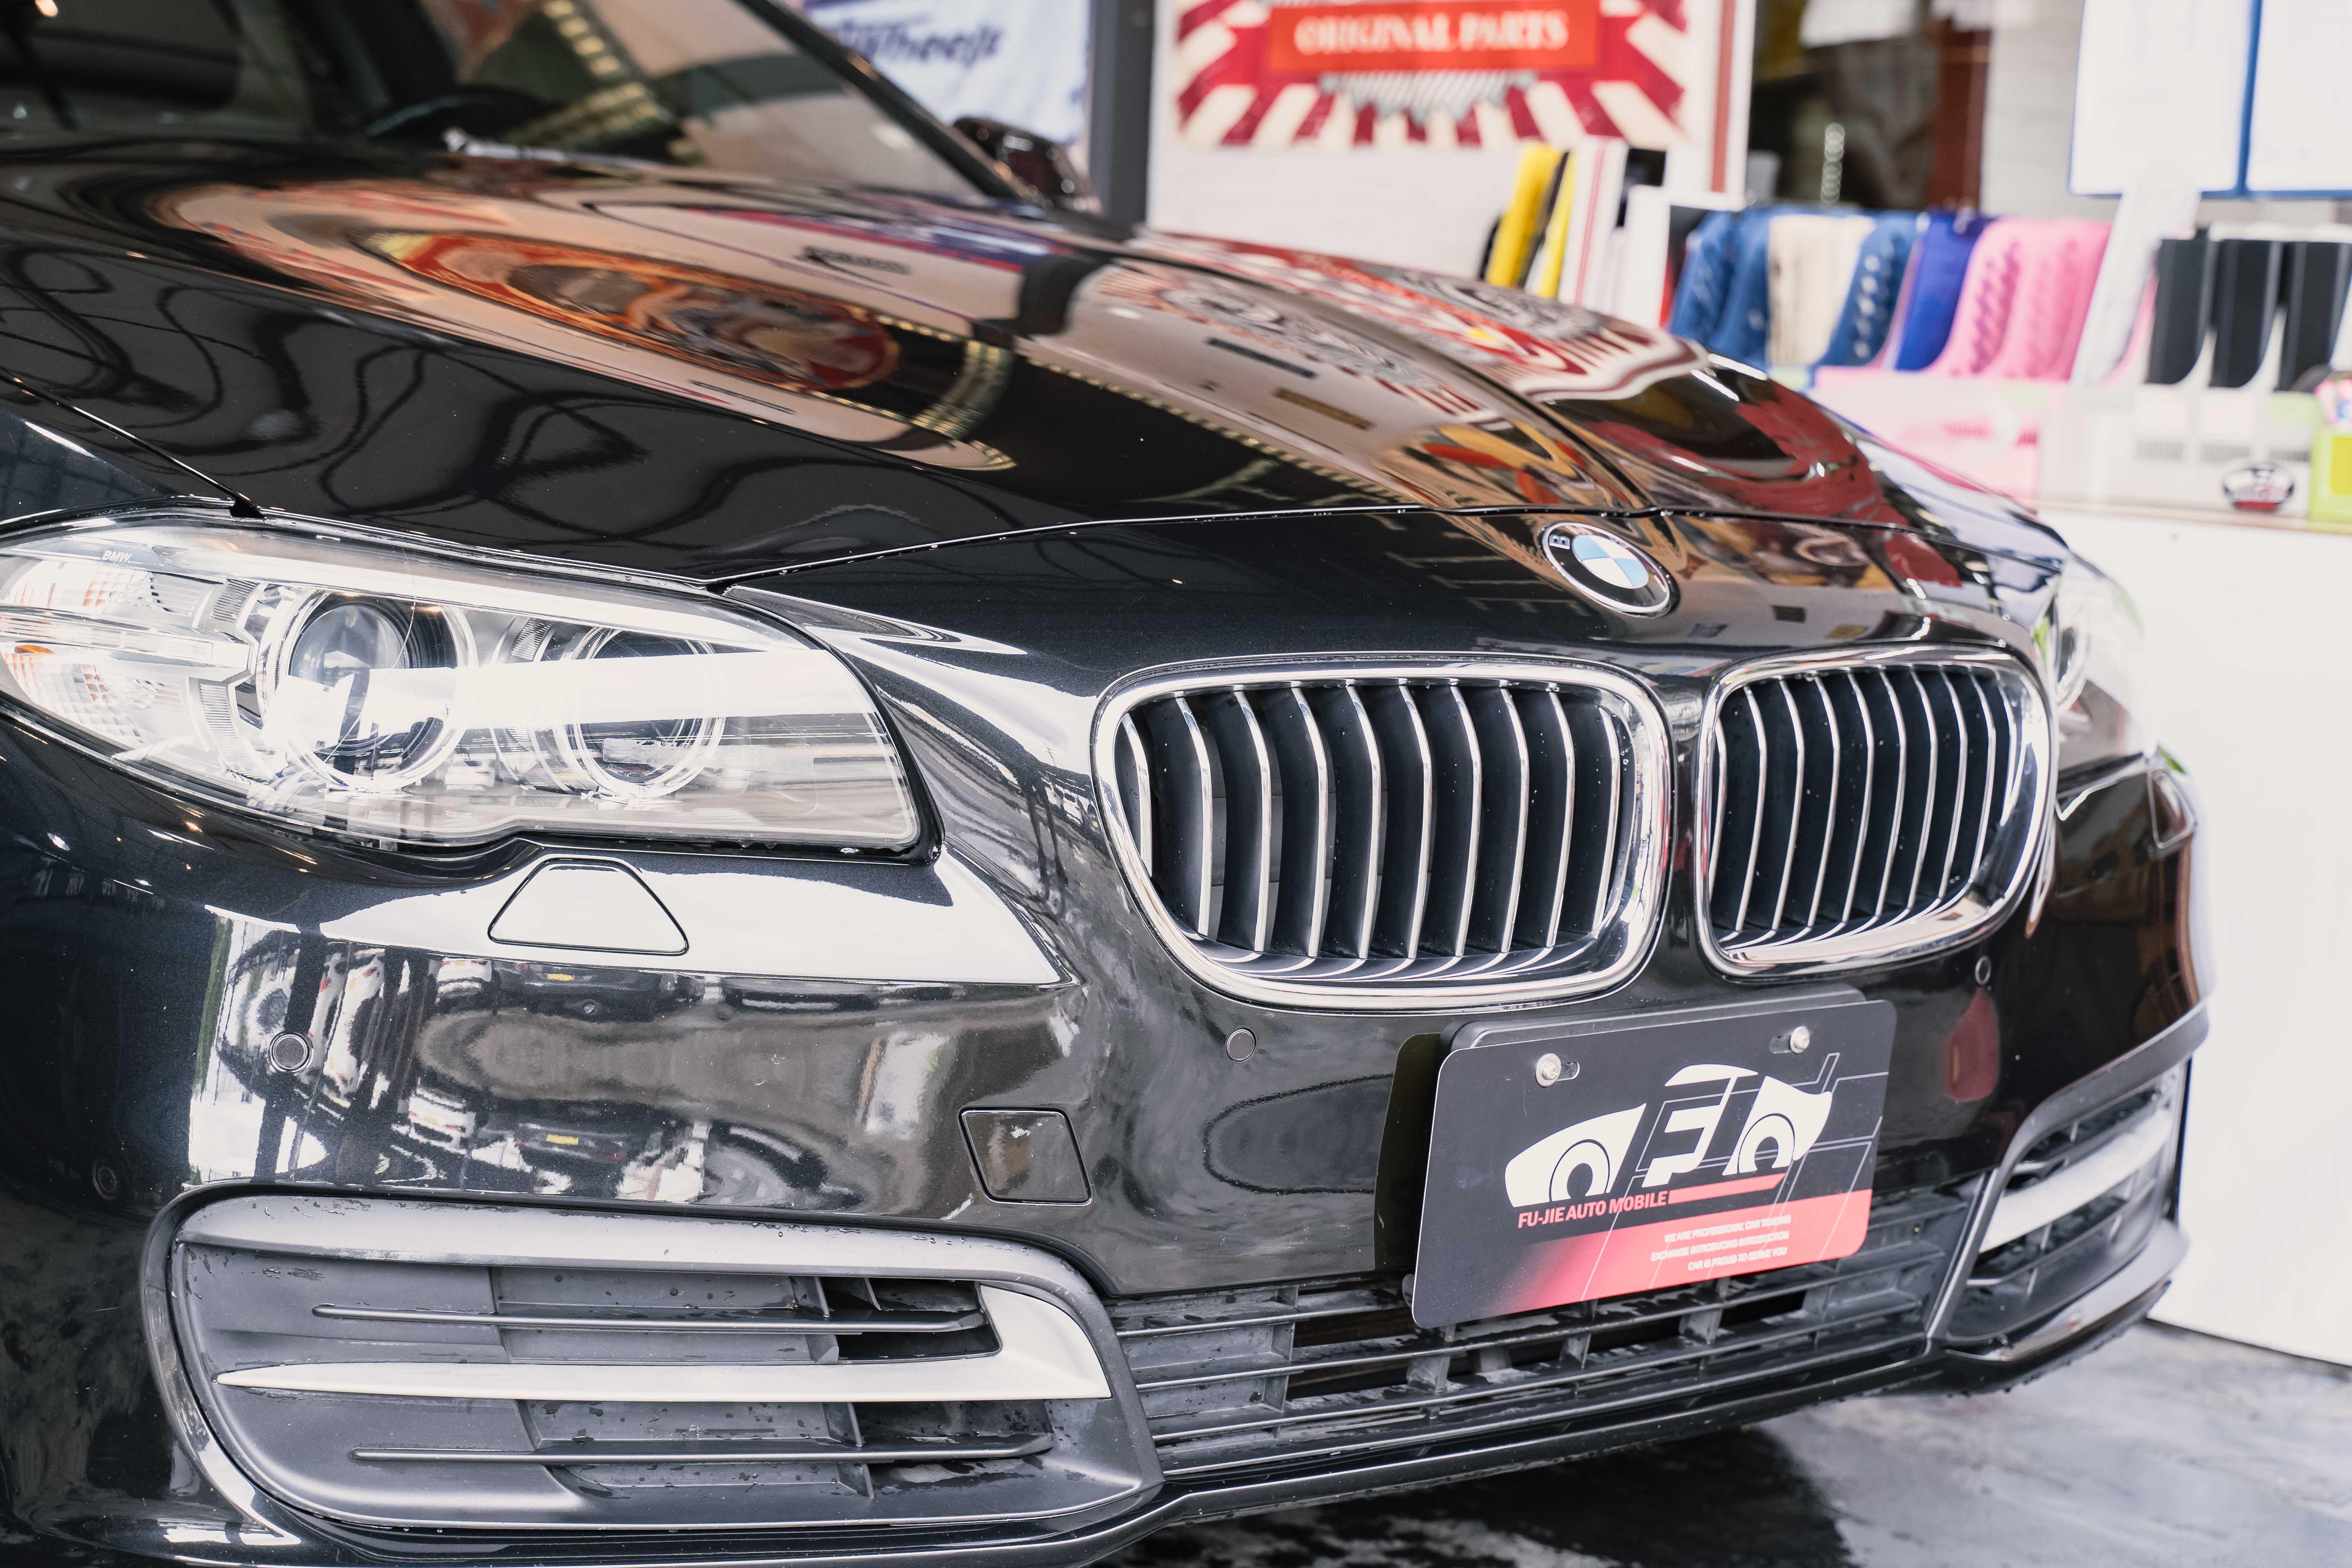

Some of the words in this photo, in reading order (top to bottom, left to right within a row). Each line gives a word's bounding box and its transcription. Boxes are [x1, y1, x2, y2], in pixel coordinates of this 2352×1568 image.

[1294, 11, 1457, 55] ORIGINAL
[1459, 10, 1568, 52] PARTS
[102, 550, 132, 562] BMW
[1518, 1206, 1566, 1229] FU-JIE
[1566, 1200, 1606, 1221] AUTO
[1609, 1190, 1669, 1214] MOBILE
[1664, 1233, 1677, 1243] WE
[1676, 1230, 1692, 1241] ARE
[1692, 1222, 1744, 1239] PROFESSIONAL
[1745, 1220, 1760, 1230] CAR
[1760, 1214, 1791, 1227] TRADING
[1651, 1246, 1690, 1261] EXCHANGE
[1690, 1238, 1738, 1255] INTRODUCING
[1738, 1230, 1790, 1247] INTRODUCTION
[1688, 1260, 1703, 1271] CAR
[1704, 1258, 1712, 1269] IS
[1711, 1254, 1738, 1267] PROUD
[1737, 1252, 1748, 1262] TO
[1748, 1248, 1771, 1261] SERVE
[1772, 1246, 1788, 1257] YOU
